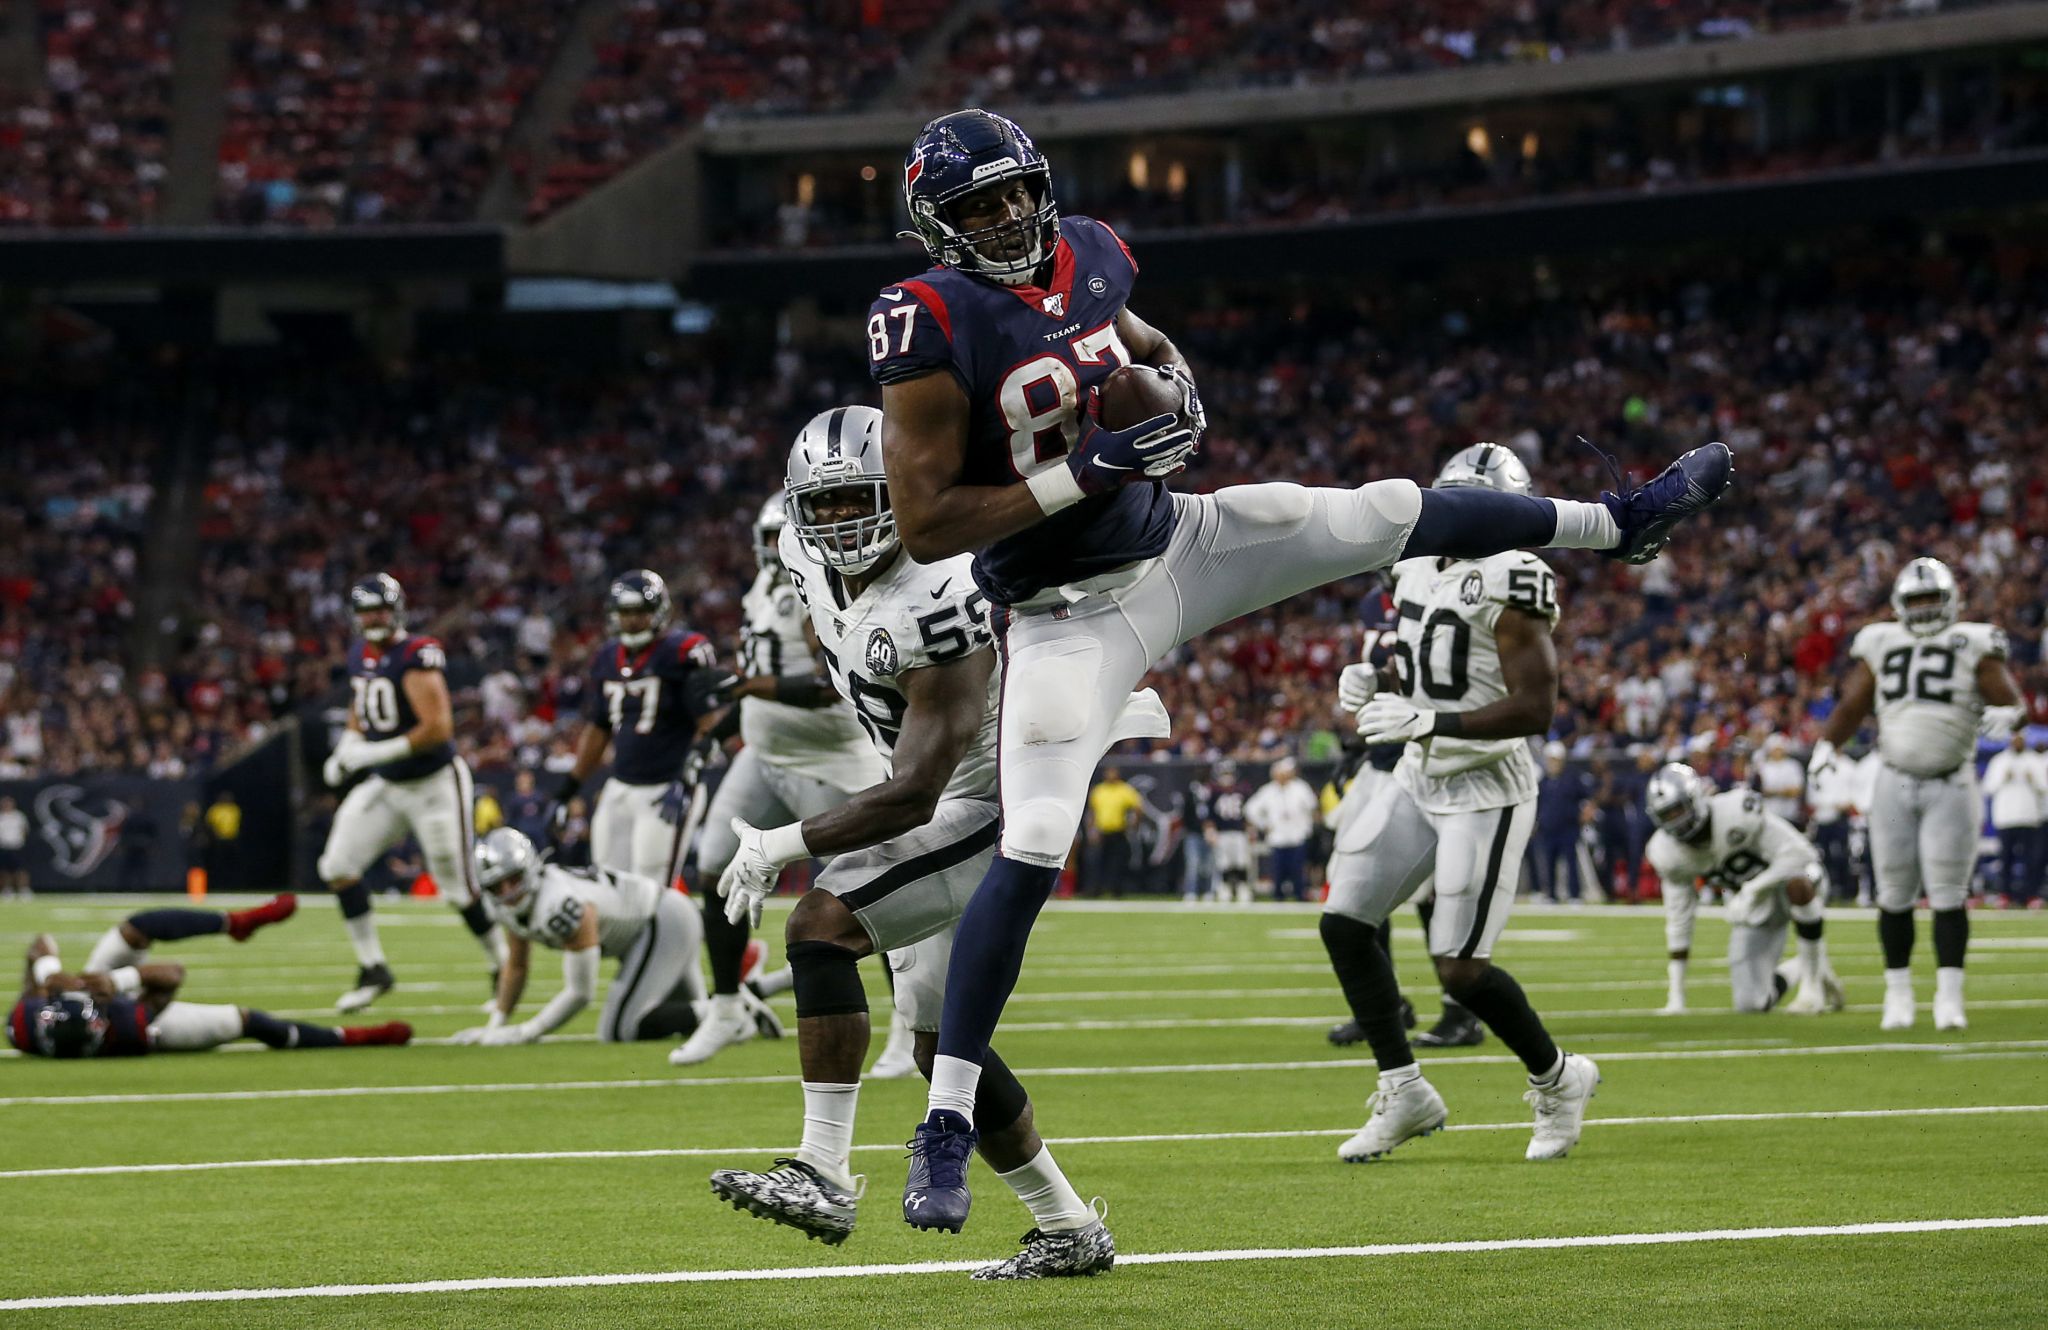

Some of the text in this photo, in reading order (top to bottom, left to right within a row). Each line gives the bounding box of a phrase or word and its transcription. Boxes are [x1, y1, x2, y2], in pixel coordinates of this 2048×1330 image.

[978, 160, 1010, 172] TEXANS
[867, 303, 919, 361] 87
[1043, 323, 1081, 342] TEXANS
[995, 319, 1131, 480] 87
[1508, 569, 1556, 609] 50
[1396, 600, 1471, 701] 50
[1883, 643, 1955, 702] 92
[603, 676, 660, 734] 77
